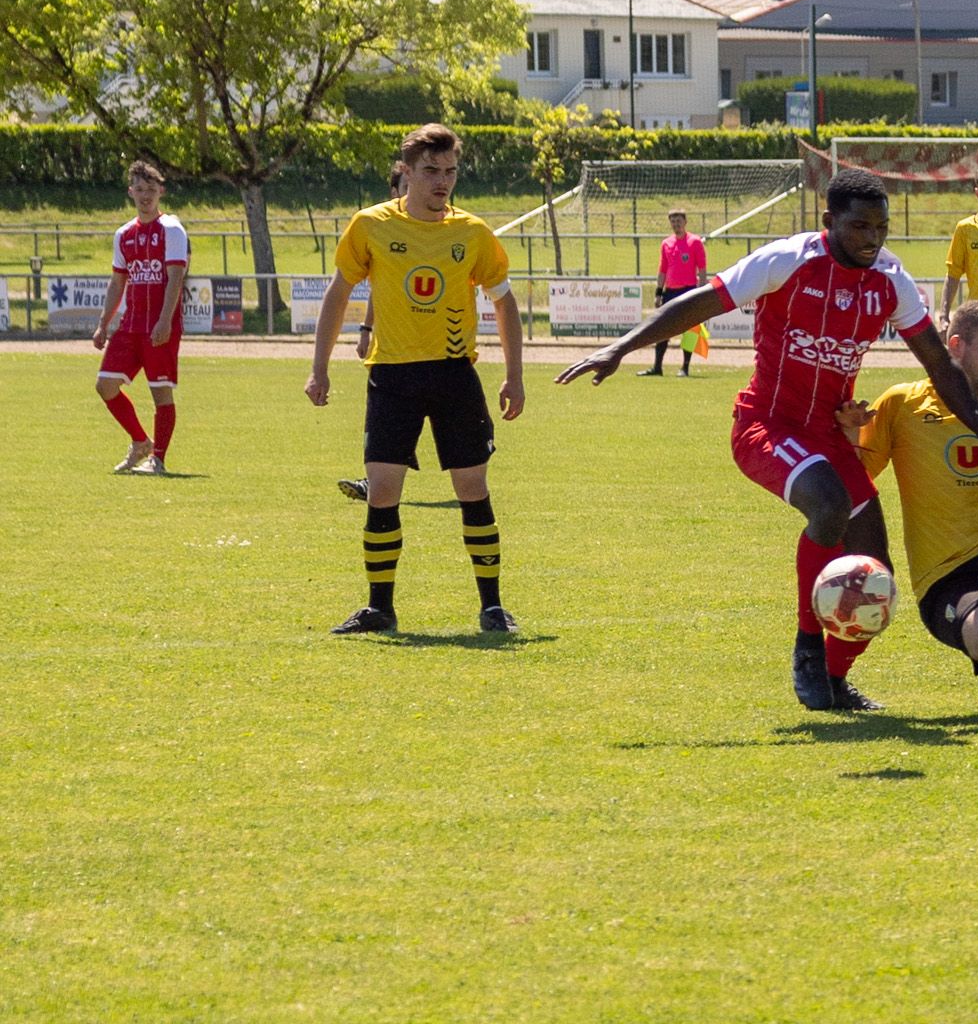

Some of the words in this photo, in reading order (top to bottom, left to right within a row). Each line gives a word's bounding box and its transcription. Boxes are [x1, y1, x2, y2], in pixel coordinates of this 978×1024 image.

[151, 233, 158, 246] 3
[74, 280, 108, 288] Ambulan
[414, 276, 436, 296] U
[802, 286, 824, 298] JAKO
[864, 290, 882, 316] 11
[410, 306, 436, 314] Tiercé
[772, 437, 809, 466] 11
